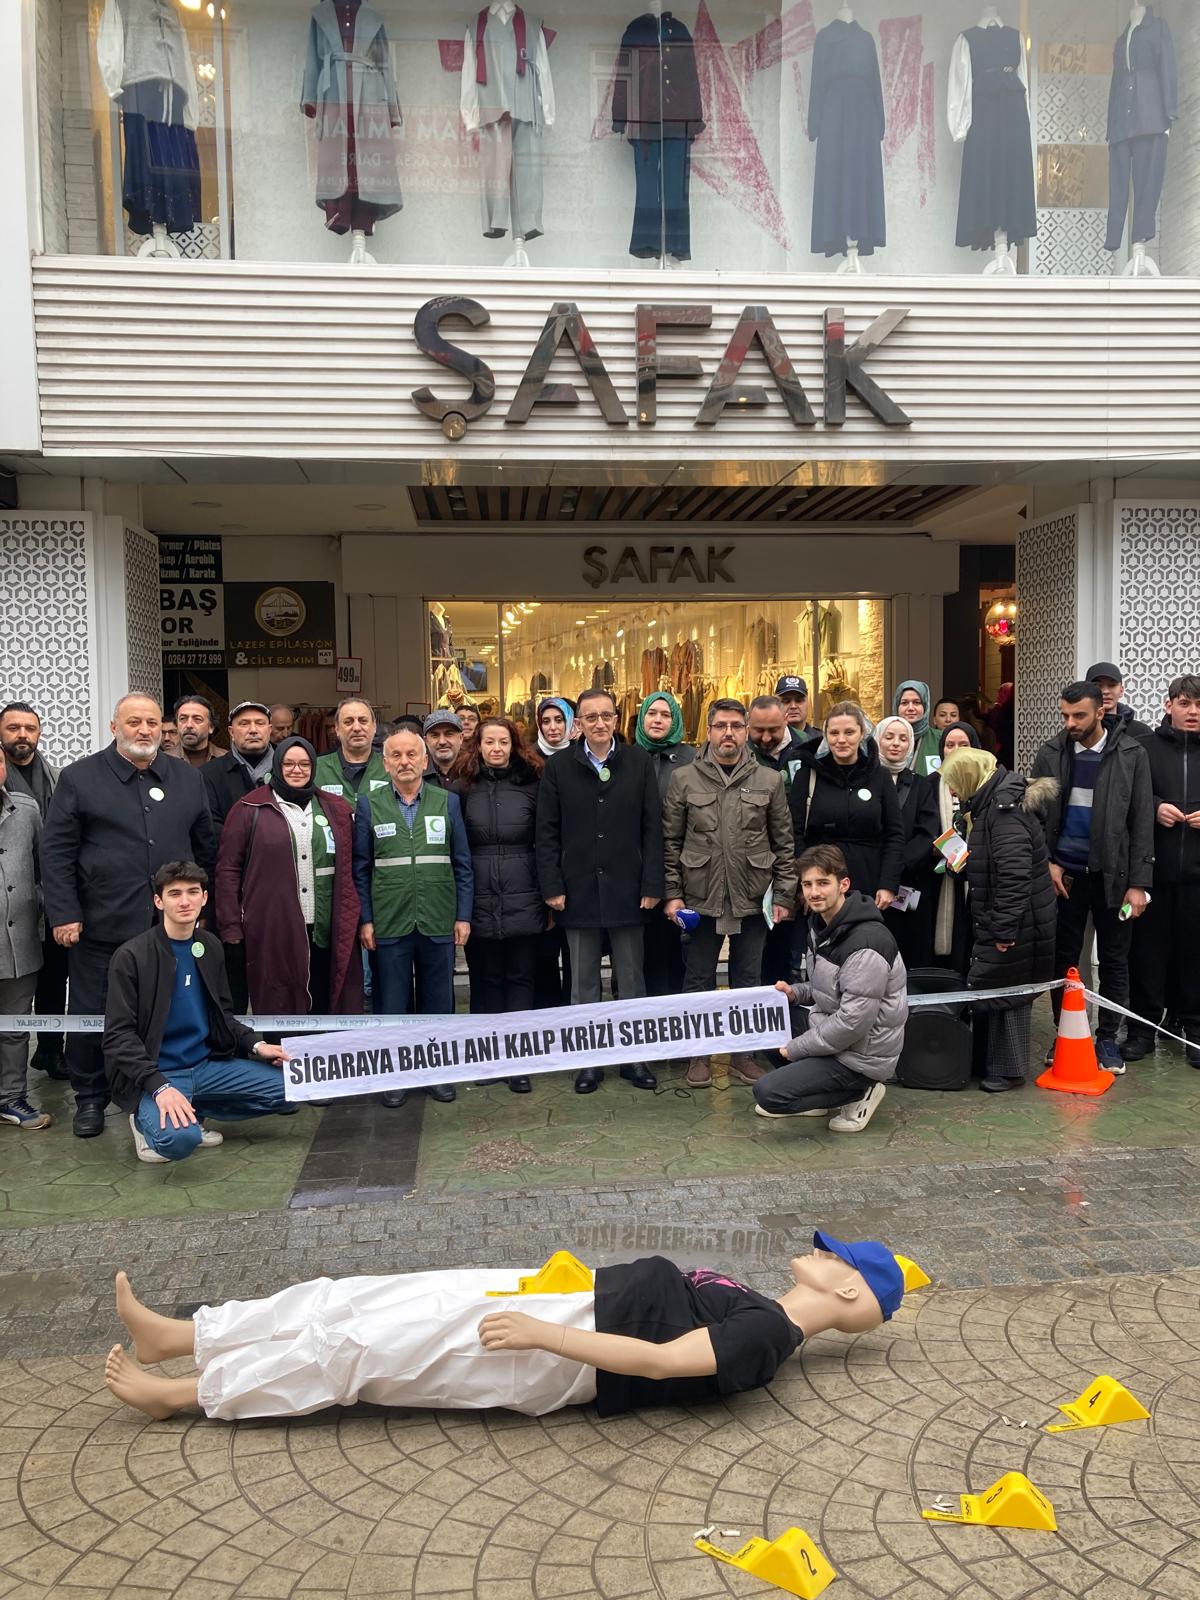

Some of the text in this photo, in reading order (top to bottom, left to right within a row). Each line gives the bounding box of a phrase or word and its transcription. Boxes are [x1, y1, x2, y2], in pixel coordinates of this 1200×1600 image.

[411, 296, 912, 441] ŞAFAK
[160, 541, 184, 550] rmer
[194, 540, 221, 550] Pilates
[189, 567, 216, 578] Karate
[582, 546, 736, 589] ŞAFAK
[230, 639, 332, 649] LAZER EPİLASYON
[168, 654, 186, 665] 0264
[187, 654, 196, 665] 27
[198, 654, 207, 665] 72
[208, 654, 222, 665] 999
[235, 652, 249, 665] &
[250, 654, 274, 665] CİLT
[289, 1003, 786, 1084] SİGARAYA BAĞLI ANİ KALP KRİZİ SEBEBİYLE ÖLÜM
[1089, 1391, 1102, 1408] 4
[800, 1548, 817, 1576] 2
